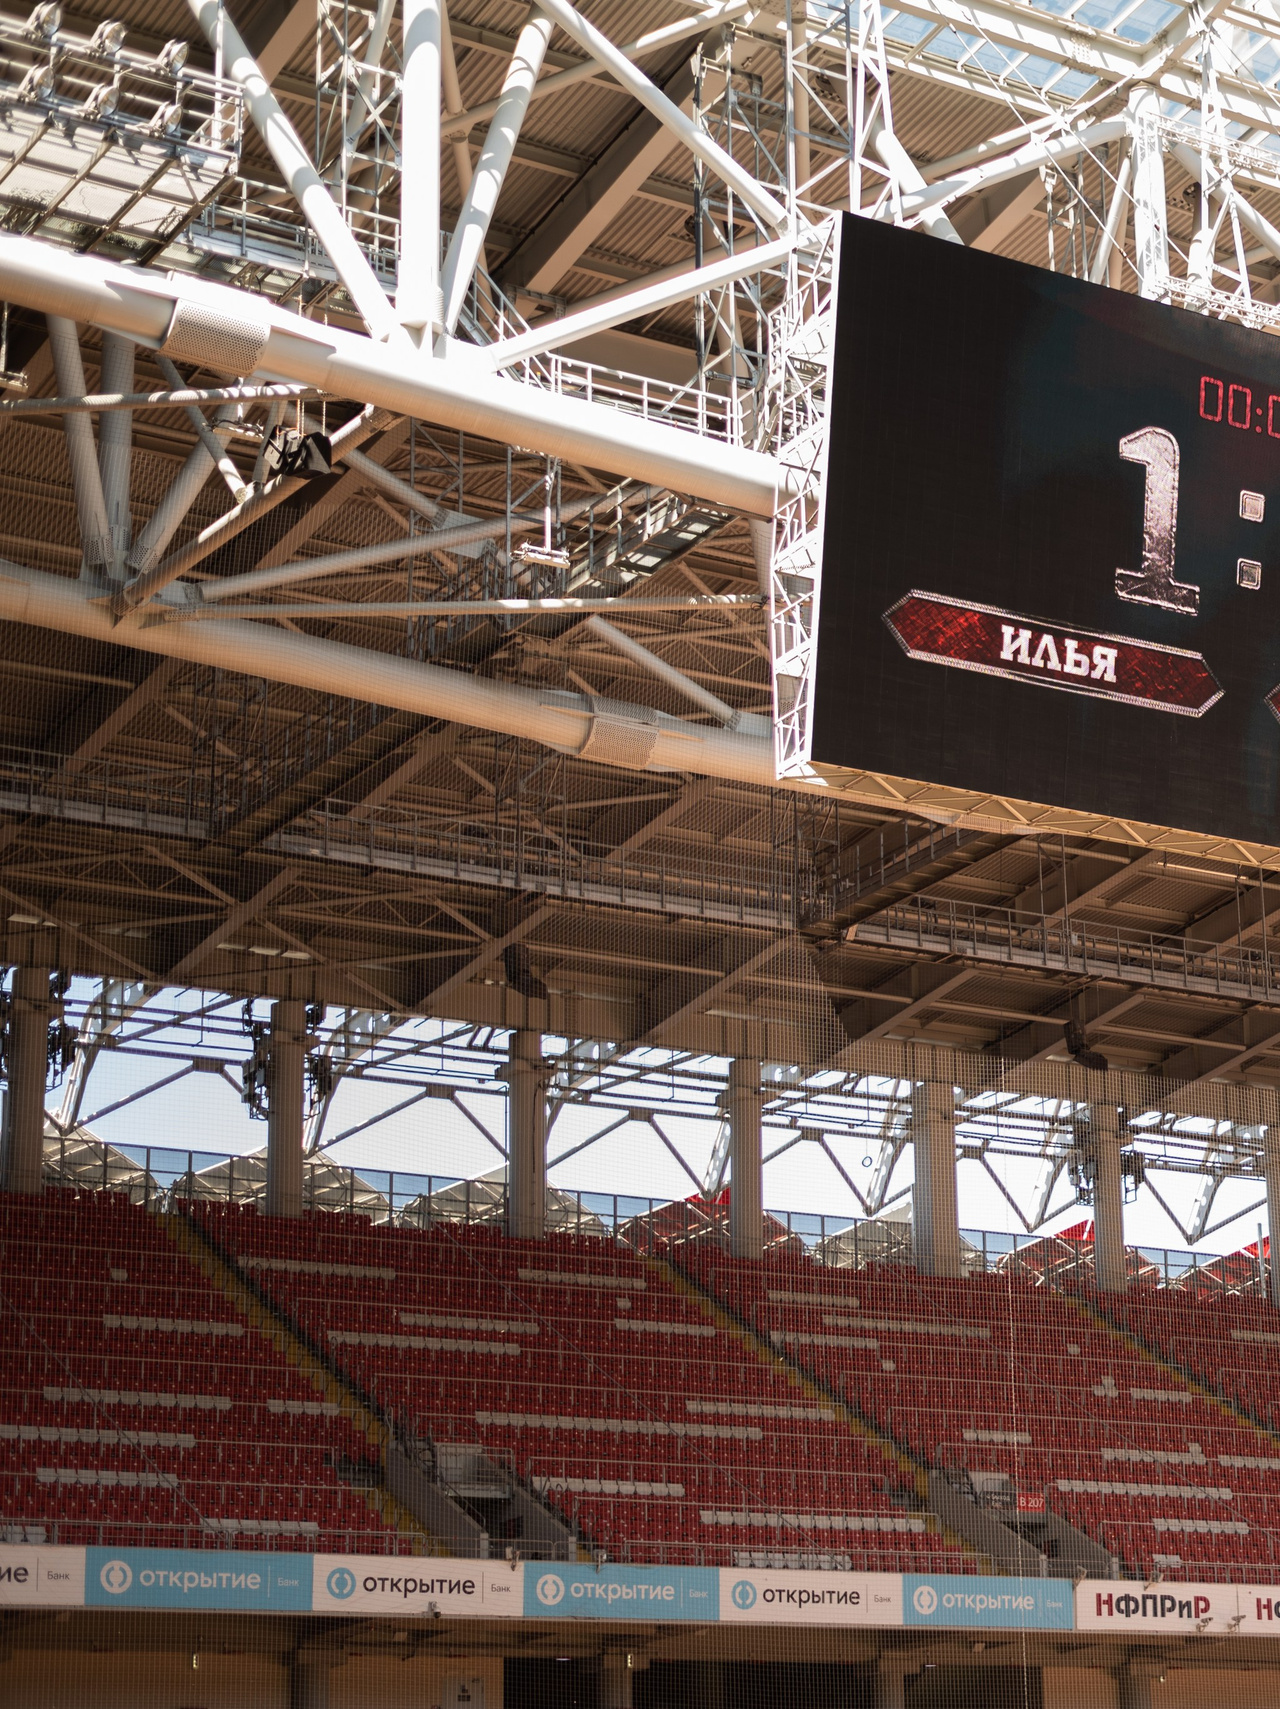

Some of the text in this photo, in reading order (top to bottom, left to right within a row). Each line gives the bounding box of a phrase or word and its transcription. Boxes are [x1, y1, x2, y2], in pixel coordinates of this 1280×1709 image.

[1000, 625, 1118, 684] ИЛЬЯ
[1028, 1497, 1044, 1508] 207
[47, 1570, 70, 1580] Банк
[140, 1569, 299, 1593] открытие Банк
[362, 1576, 511, 1599] открытие Банк
[570, 1582, 708, 1604] открытие Банк
[762, 1587, 892, 1608] открытие Банк
[942, 1592, 1034, 1613] открытие
[1095, 1592, 1210, 1619] НФПРиР
